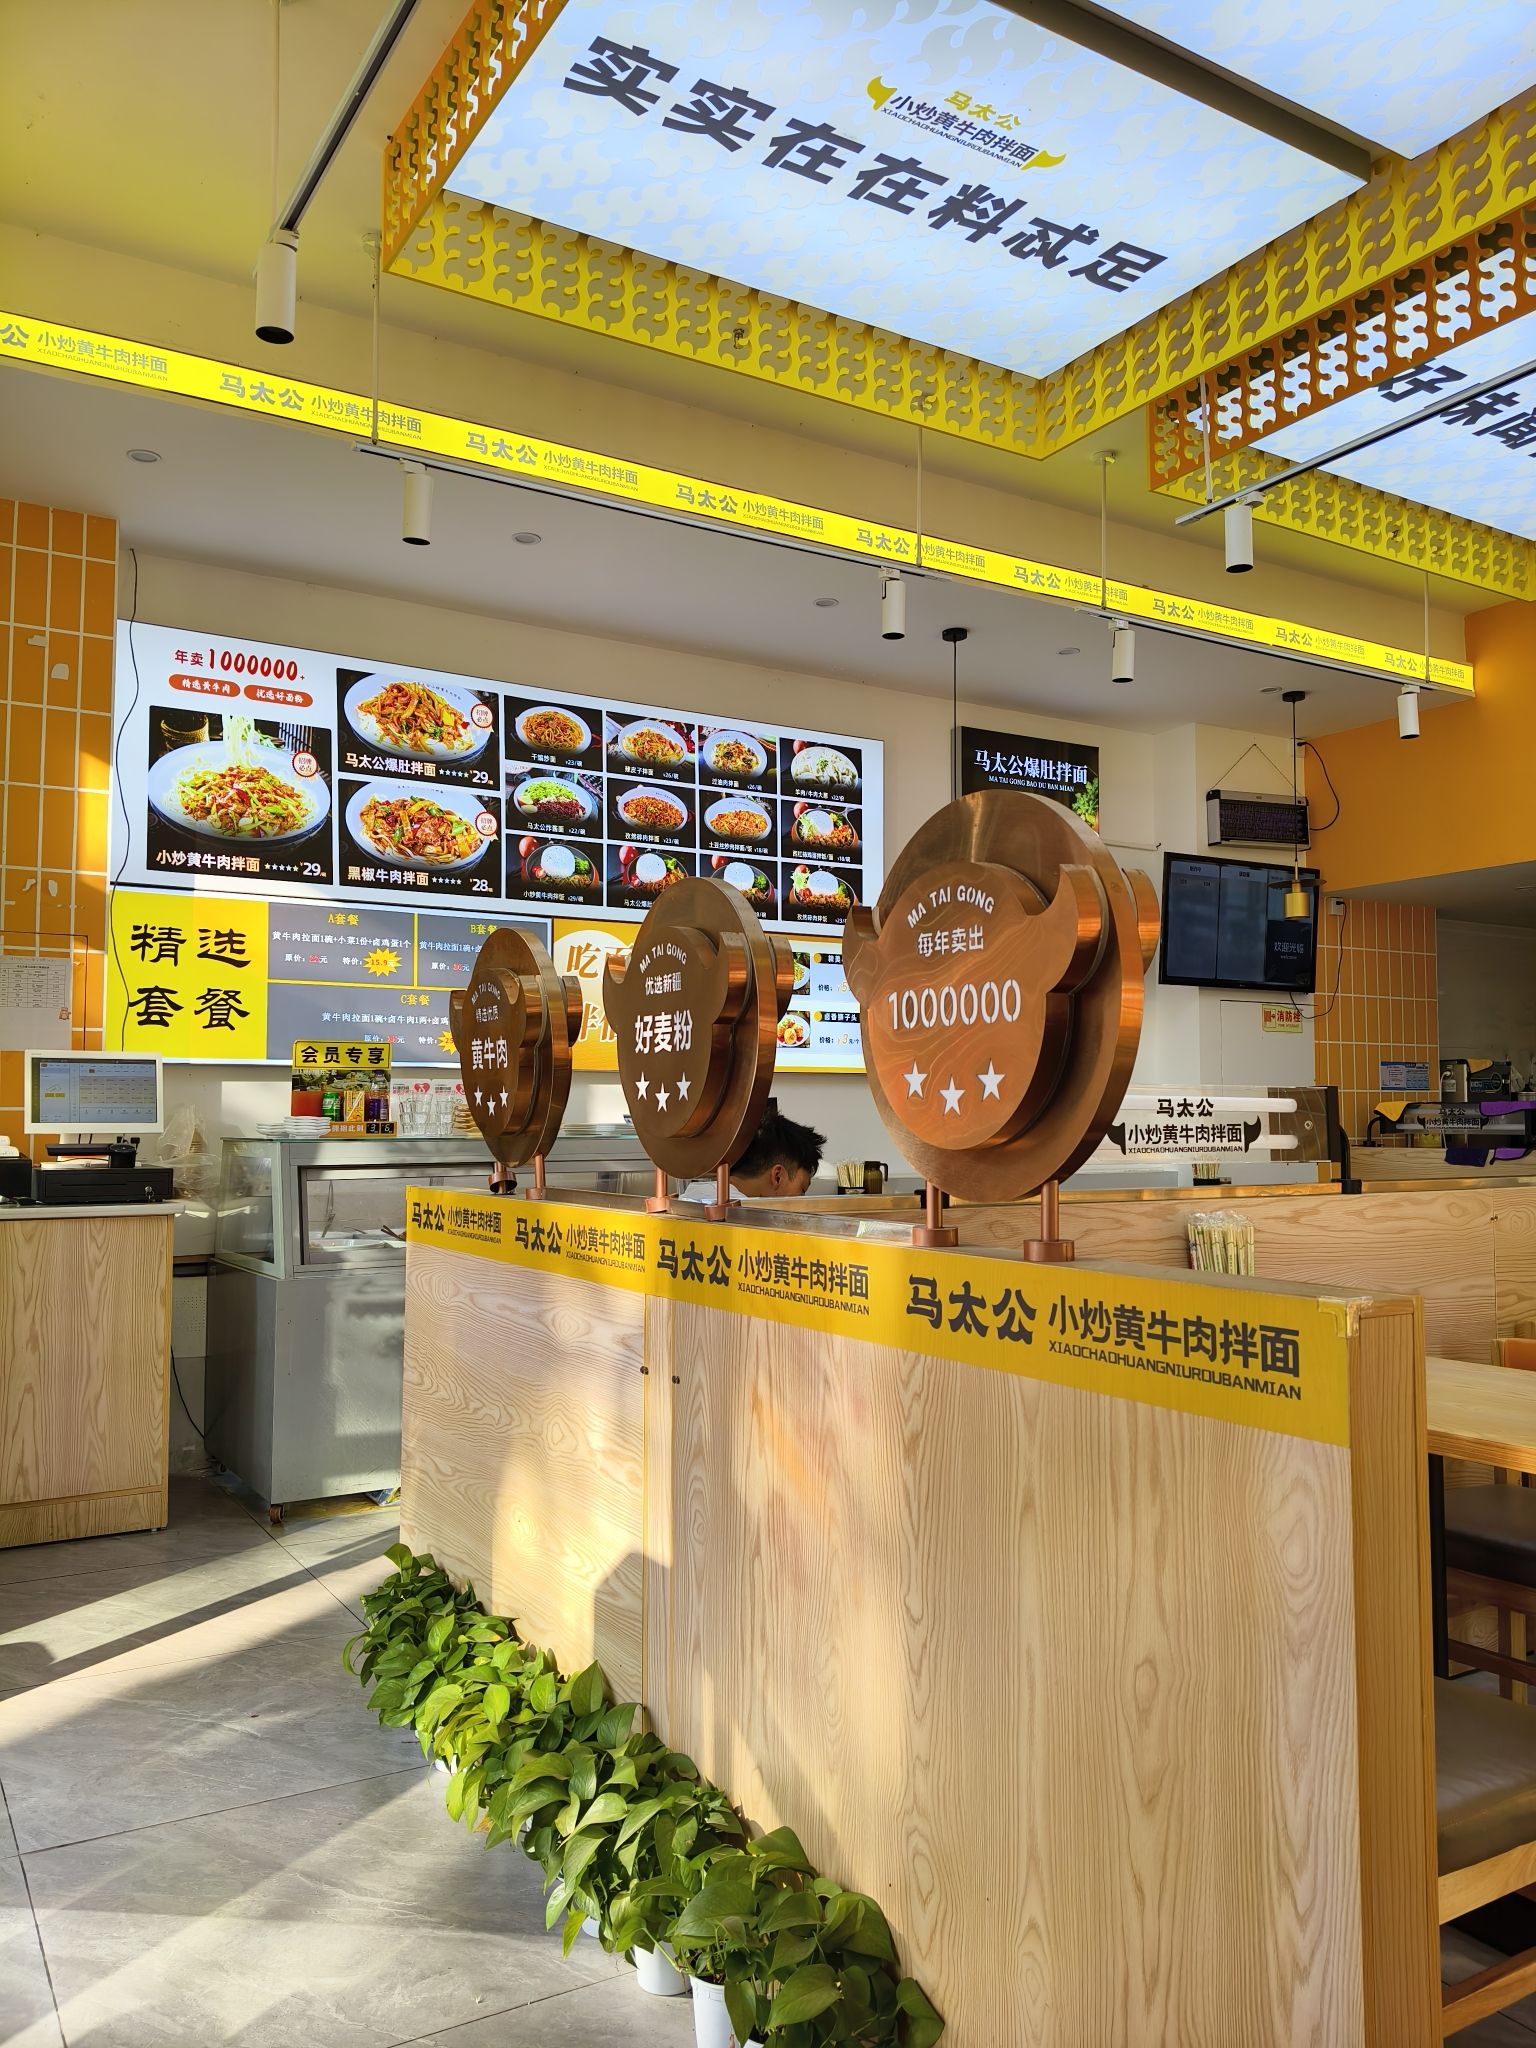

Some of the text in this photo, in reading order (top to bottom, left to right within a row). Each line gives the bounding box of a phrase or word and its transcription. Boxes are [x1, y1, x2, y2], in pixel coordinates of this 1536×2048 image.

[944, 90, 1020, 129] 马太公
[889, 95, 1039, 162] 小炒黄牛肉拌面
[562, 35, 1169, 293] 实实在在料忒足
[37, 331, 168, 374] 小炒黄牛肉拌面
[220, 372, 422, 434] 马太公 小炒黄牛肉拌面
[466, 431, 638, 486] 马太公 小炒黄牛肉拌面
[676, 483, 738, 514] 马太公
[743, 500, 824, 530] 小炒黄牛肉拌面
[856, 528, 910, 555] 马太公
[1014, 565, 1061, 589] 马太公
[1152, 598, 1195, 620] 马太公
[1275, 627, 1313, 647] 马太公
[1384, 652, 1418, 672] 马太公
[345, 752, 437, 777] 马太公爆肚拌面
[974, 749, 1088, 785] 马太公爆肚拌面
[988, 775, 998, 783] MA
[999, 776, 1009, 784] TAI
[1009, 777, 1026, 787] GONG
[1026, 779, 1038, 788] BAO
[1038, 780, 1047, 789] DU
[156, 850, 260, 873] 小炒黄牛肉拌面
[347, 865, 429, 886] 黑椒牛肉拌面
[907, 885, 995, 928] MA TAI GONG
[130, 924, 252, 968] 精选
[918, 924, 984, 957] 每年卖出
[640, 943, 687, 974] MA TAI GONG
[645, 971, 682, 996] 优选新疆
[128, 985, 251, 1031] 套餐
[888, 978, 1022, 1030] 1000000
[634, 1009, 693, 1055] 好麦粉
[301, 1045, 385, 1064] 会员专享
[472, 1035, 508, 1070] 黄牛肉
[1156, 1098, 1214, 1118] 马太公
[1128, 1123, 1242, 1144] 小炒黄牛肉拌面
[411, 1202, 502, 1234] 马太公 小炒黄牛肉拌面
[514, 1216, 646, 1261] 马太公 小炒黄牛肉拌面
[656, 1237, 869, 1300] 马太公 小炒黄牛肉拌面
[906, 1273, 1300, 1378] 马太公 小炒黄牛肉拌面
[1048, 1340, 1302, 1401] XIAOCHAOHUANGNIUROUBANMIAN
